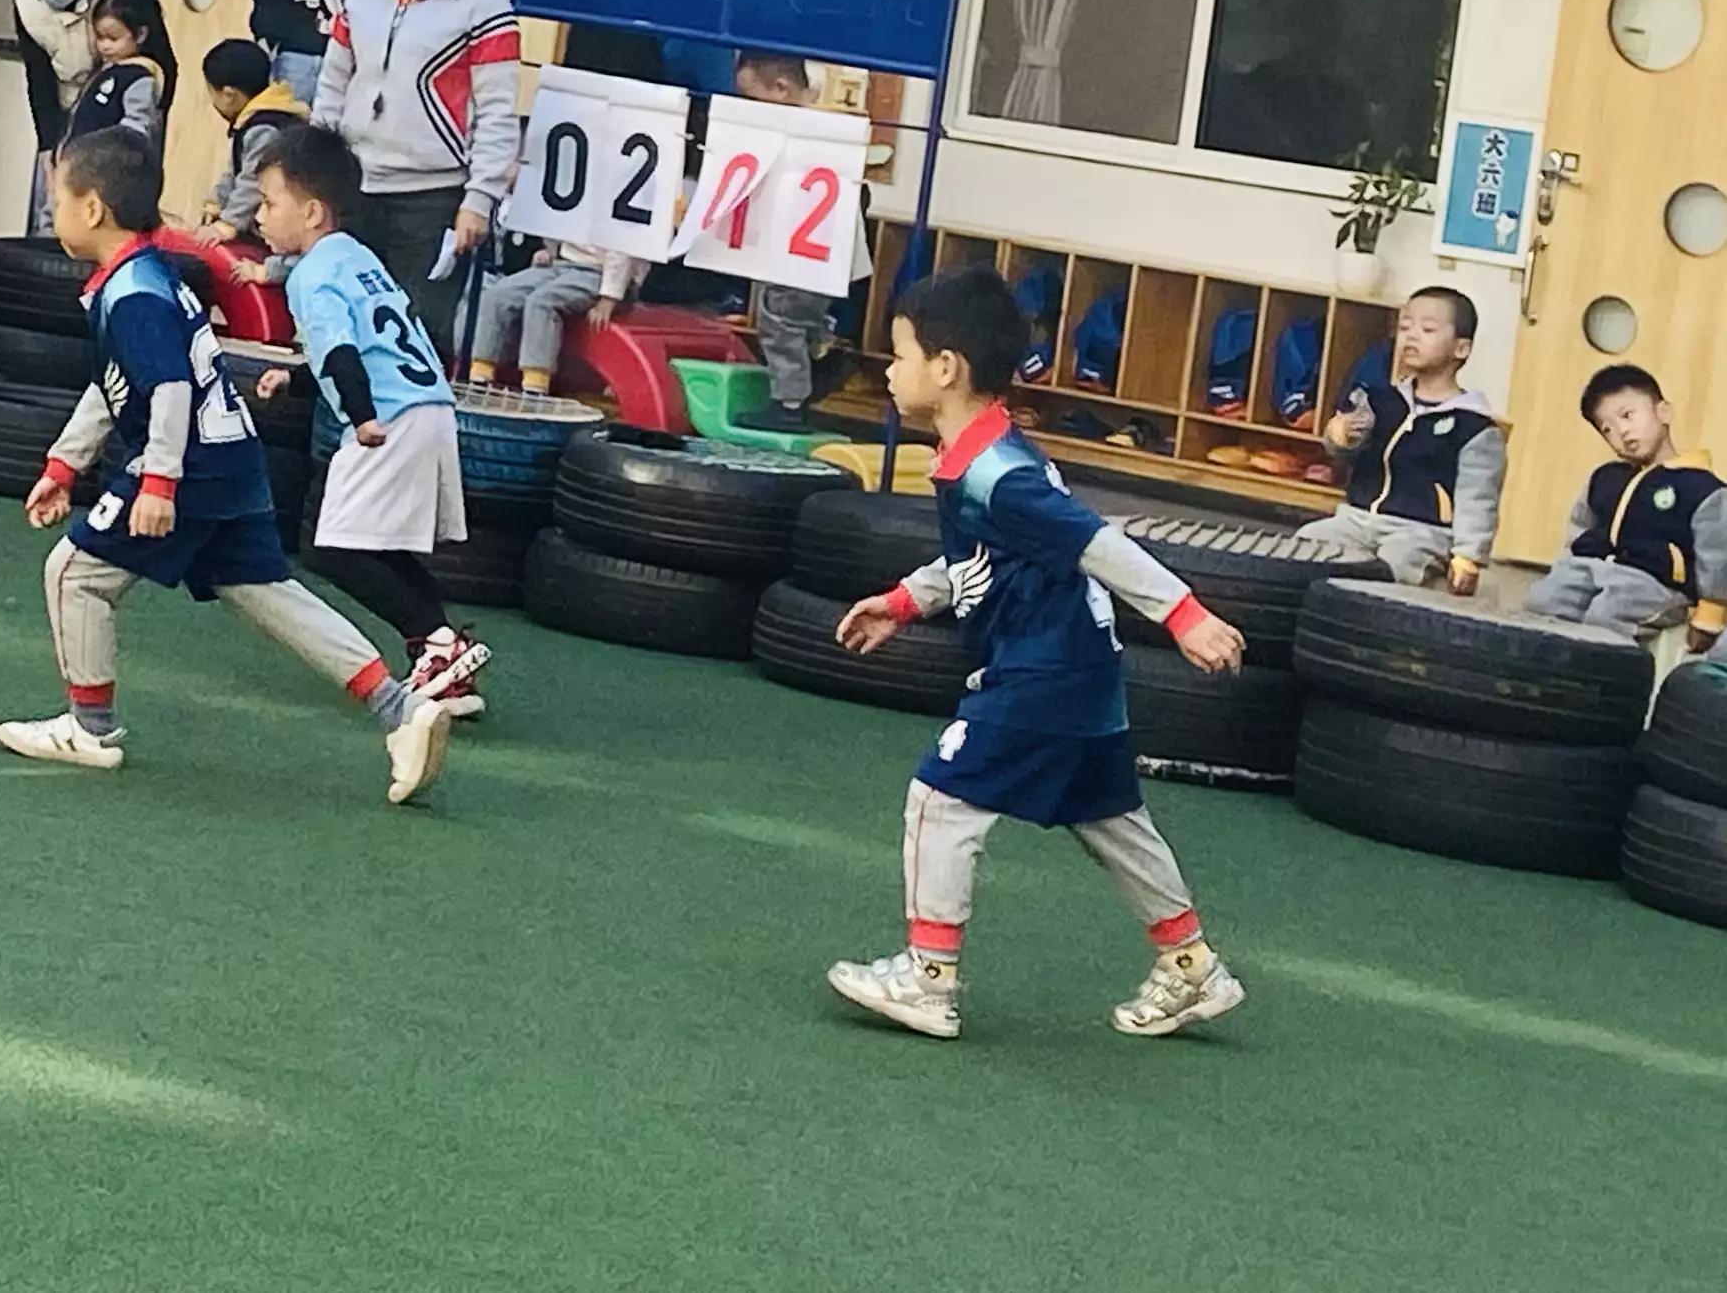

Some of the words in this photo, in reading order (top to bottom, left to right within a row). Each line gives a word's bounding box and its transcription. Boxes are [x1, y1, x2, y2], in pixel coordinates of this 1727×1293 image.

[541, 121, 660, 226] 02
[1475, 133, 1506, 216] 大六班
